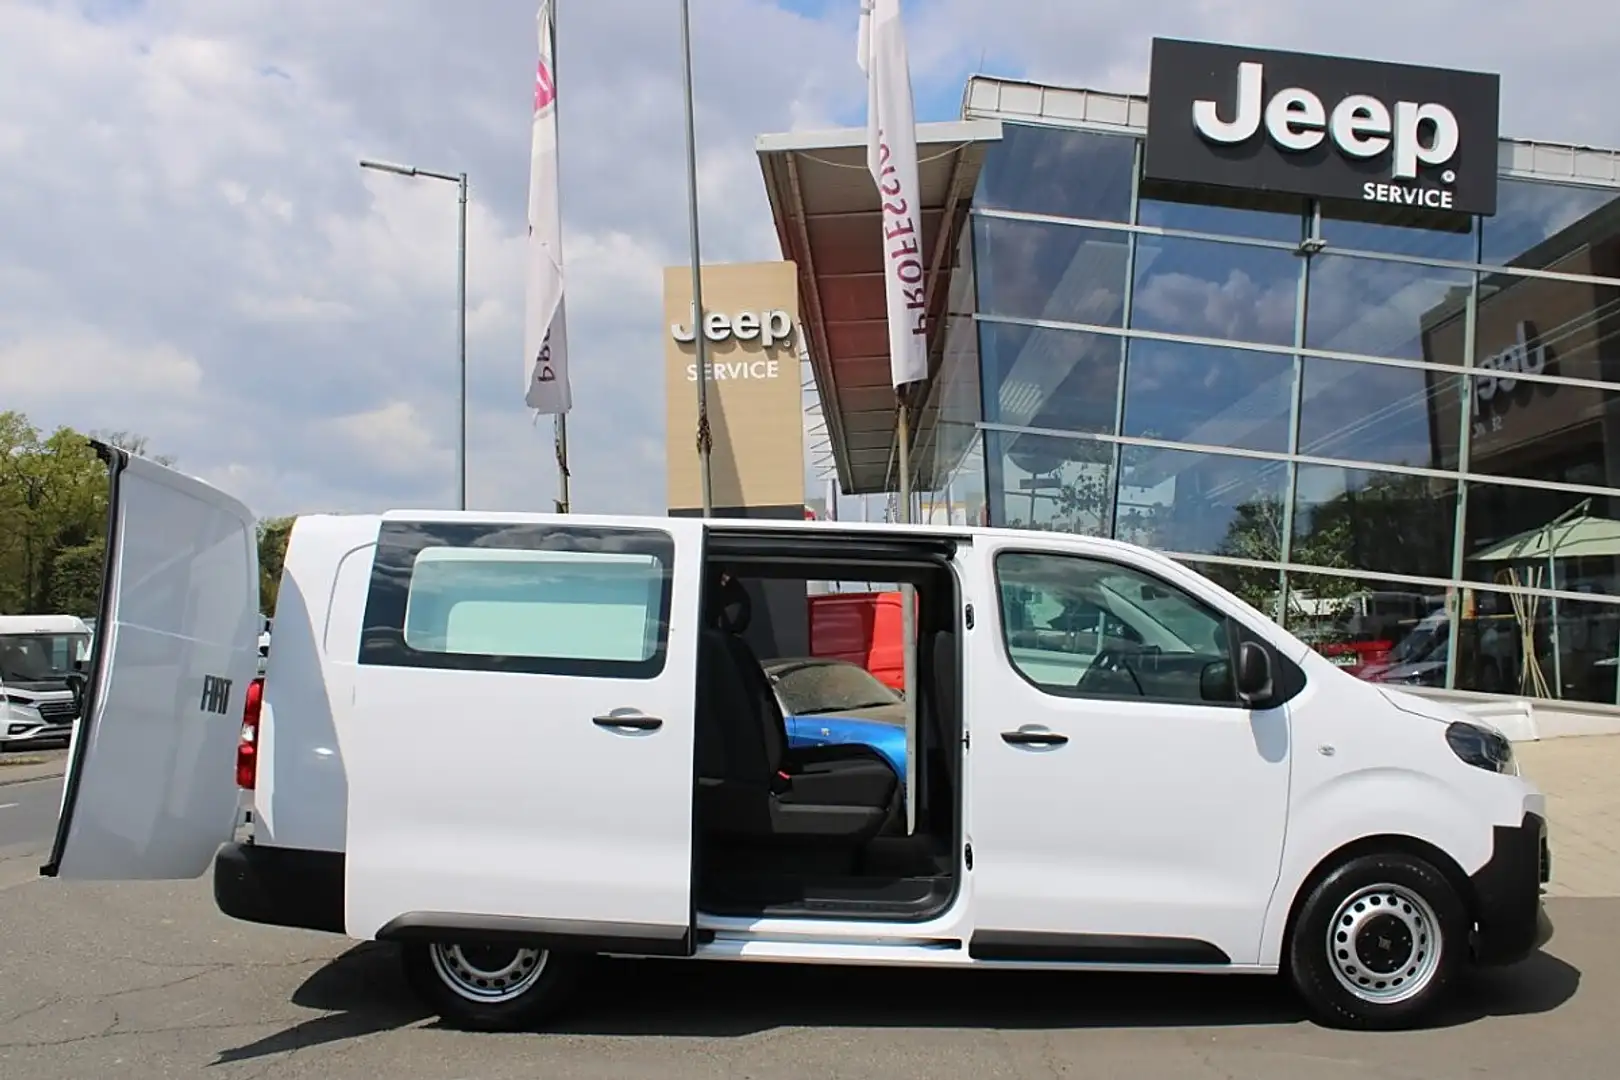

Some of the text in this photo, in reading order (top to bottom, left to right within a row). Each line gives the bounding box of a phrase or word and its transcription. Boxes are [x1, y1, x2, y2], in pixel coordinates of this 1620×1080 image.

[1192, 61, 1459, 180] Jeep
[1363, 182, 1453, 209] SERVICE
[671, 300, 792, 347] Jeep
[686, 360, 779, 381] SERVICE
[200, 674, 233, 715] FIAT
